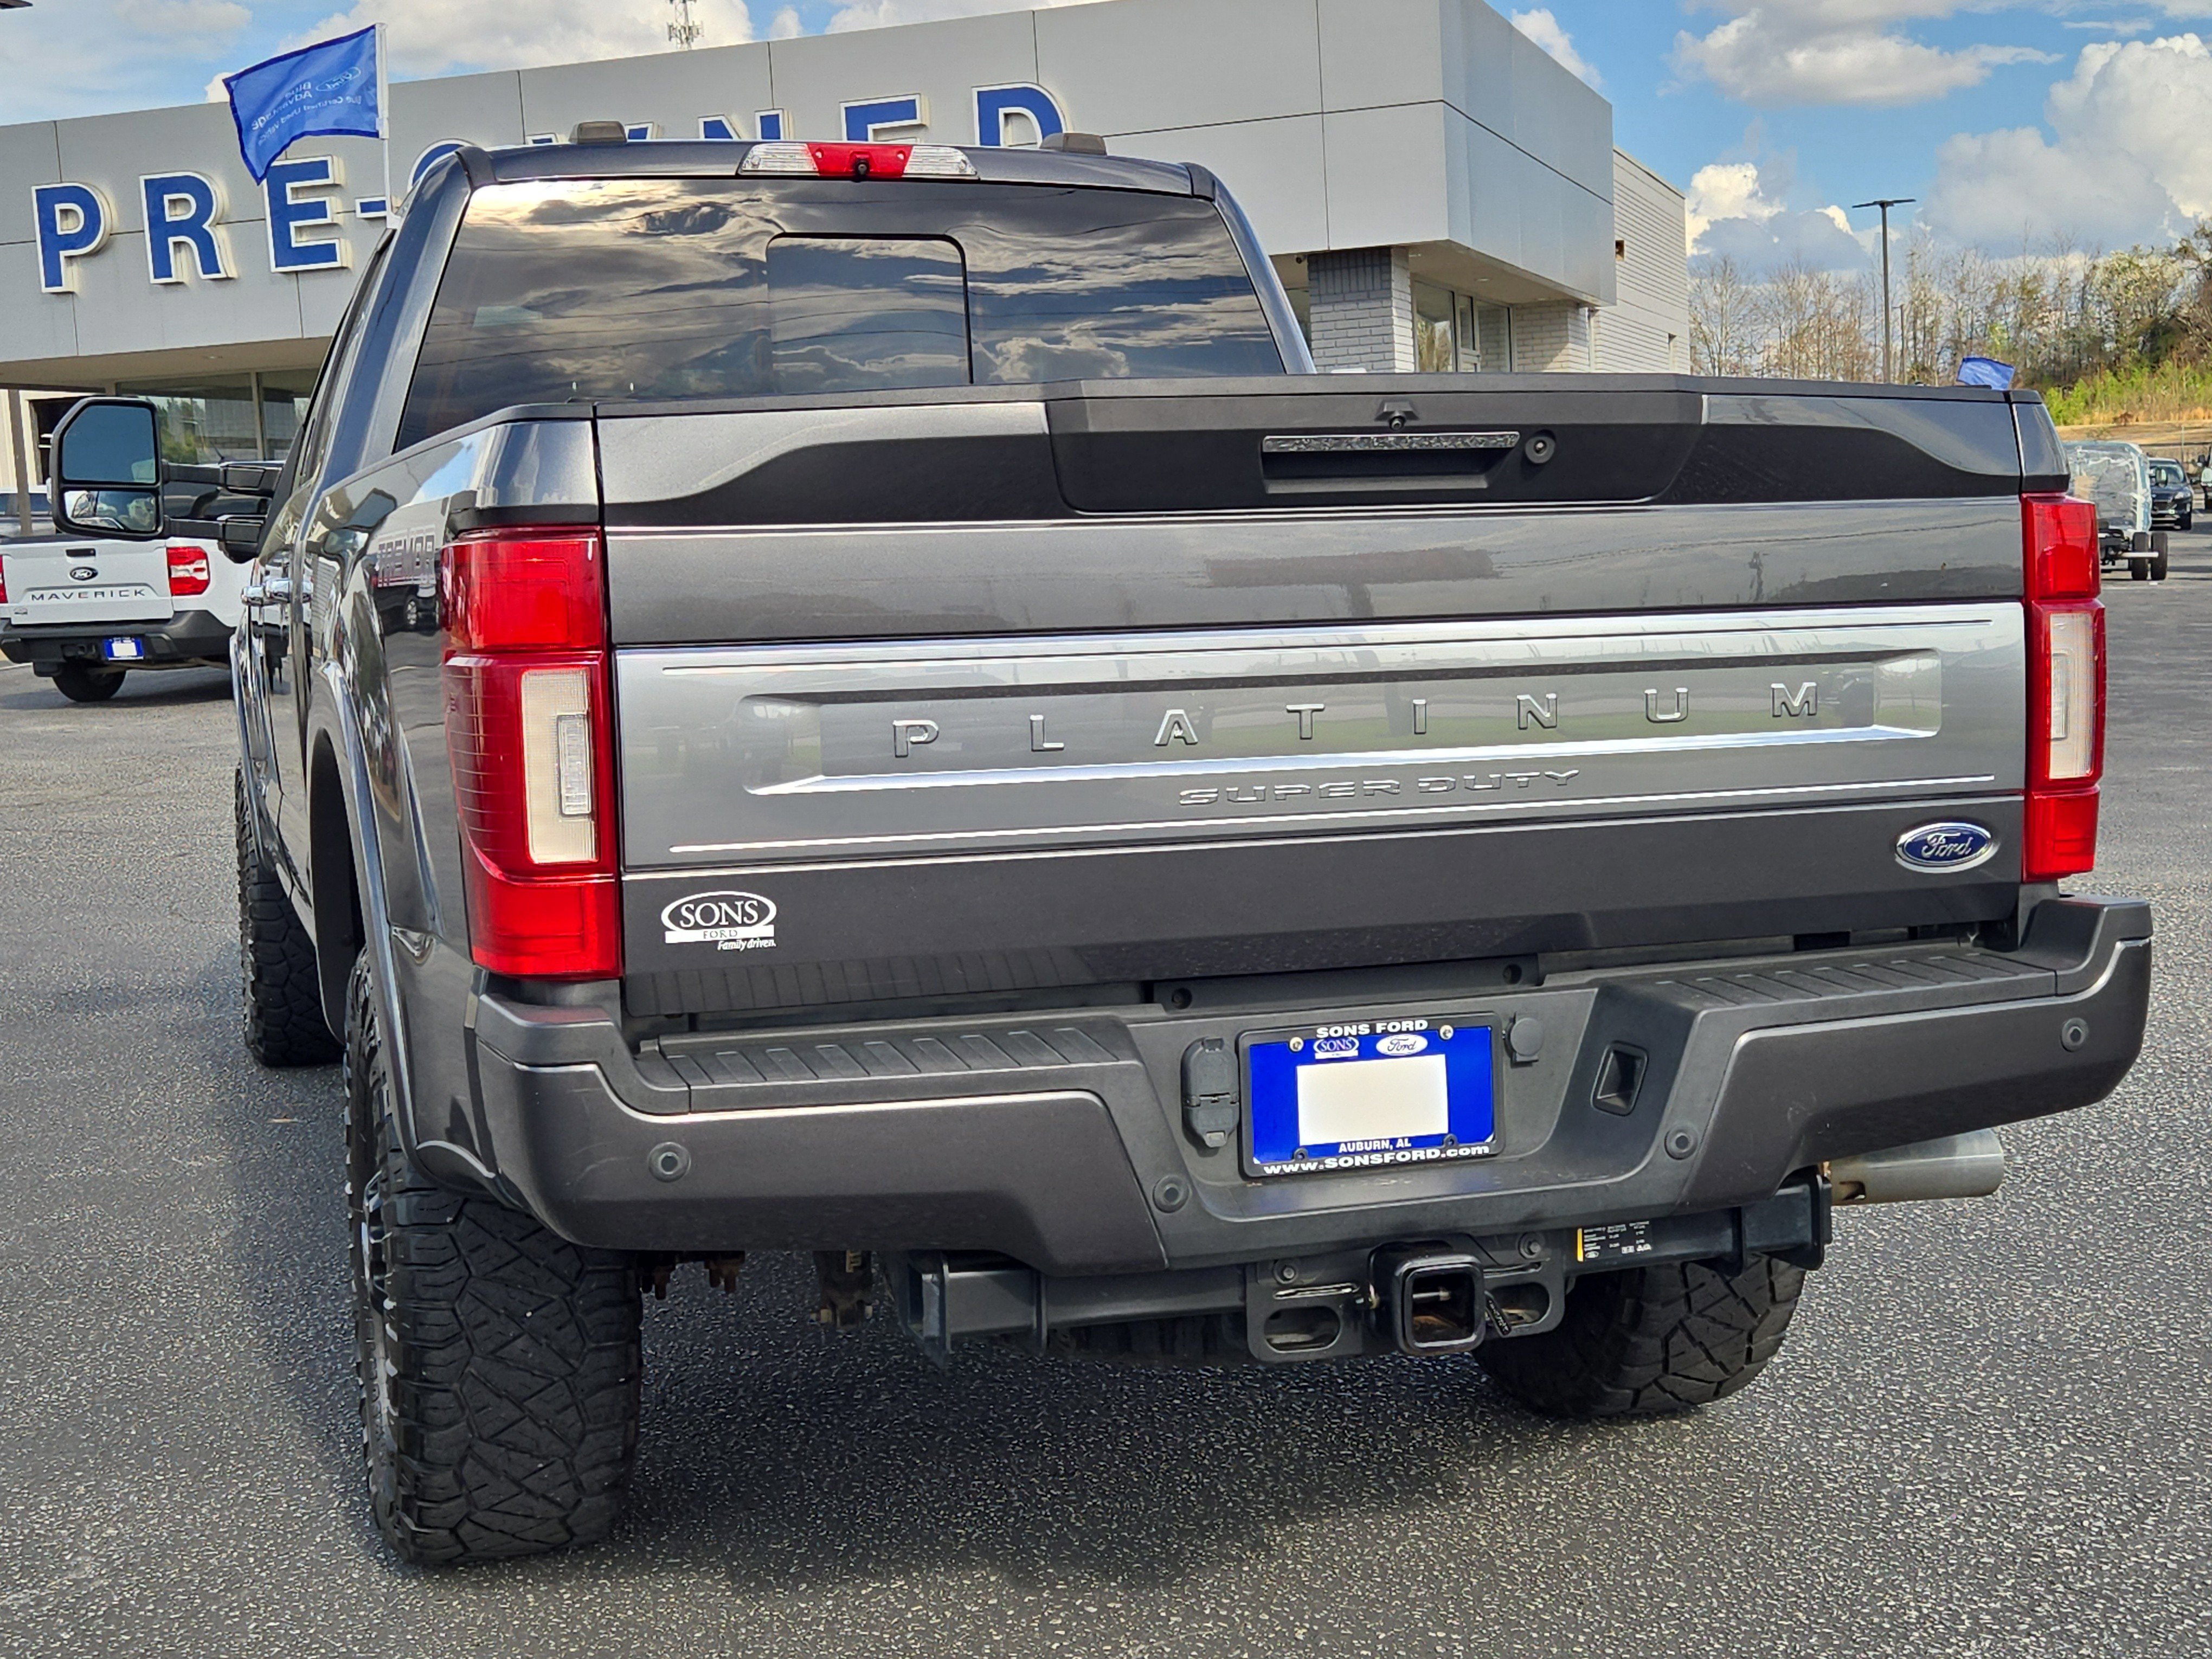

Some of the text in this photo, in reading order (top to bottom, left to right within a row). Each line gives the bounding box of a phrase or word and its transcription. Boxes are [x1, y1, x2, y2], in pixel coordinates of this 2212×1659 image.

[31, 589, 146, 601] MAVERICK
[892, 682, 1818, 757] PLATINUM
[1179, 769, 1580, 806] SUPER DUTY
[1921, 832, 1974, 858] Ford
[679, 901, 758, 928] SONS
[703, 930, 738, 939] FORD
[717, 938, 748, 951] Family
[1316, 1019, 1428, 1039] SONS FORD
[1319, 1038, 1353, 1052] SONS
[1387, 1038, 1417, 1052] Ford
[1338, 1137, 1412, 1154] AUBURN, AL
[1263, 1145, 1490, 1175] www.SONSFORD.com
